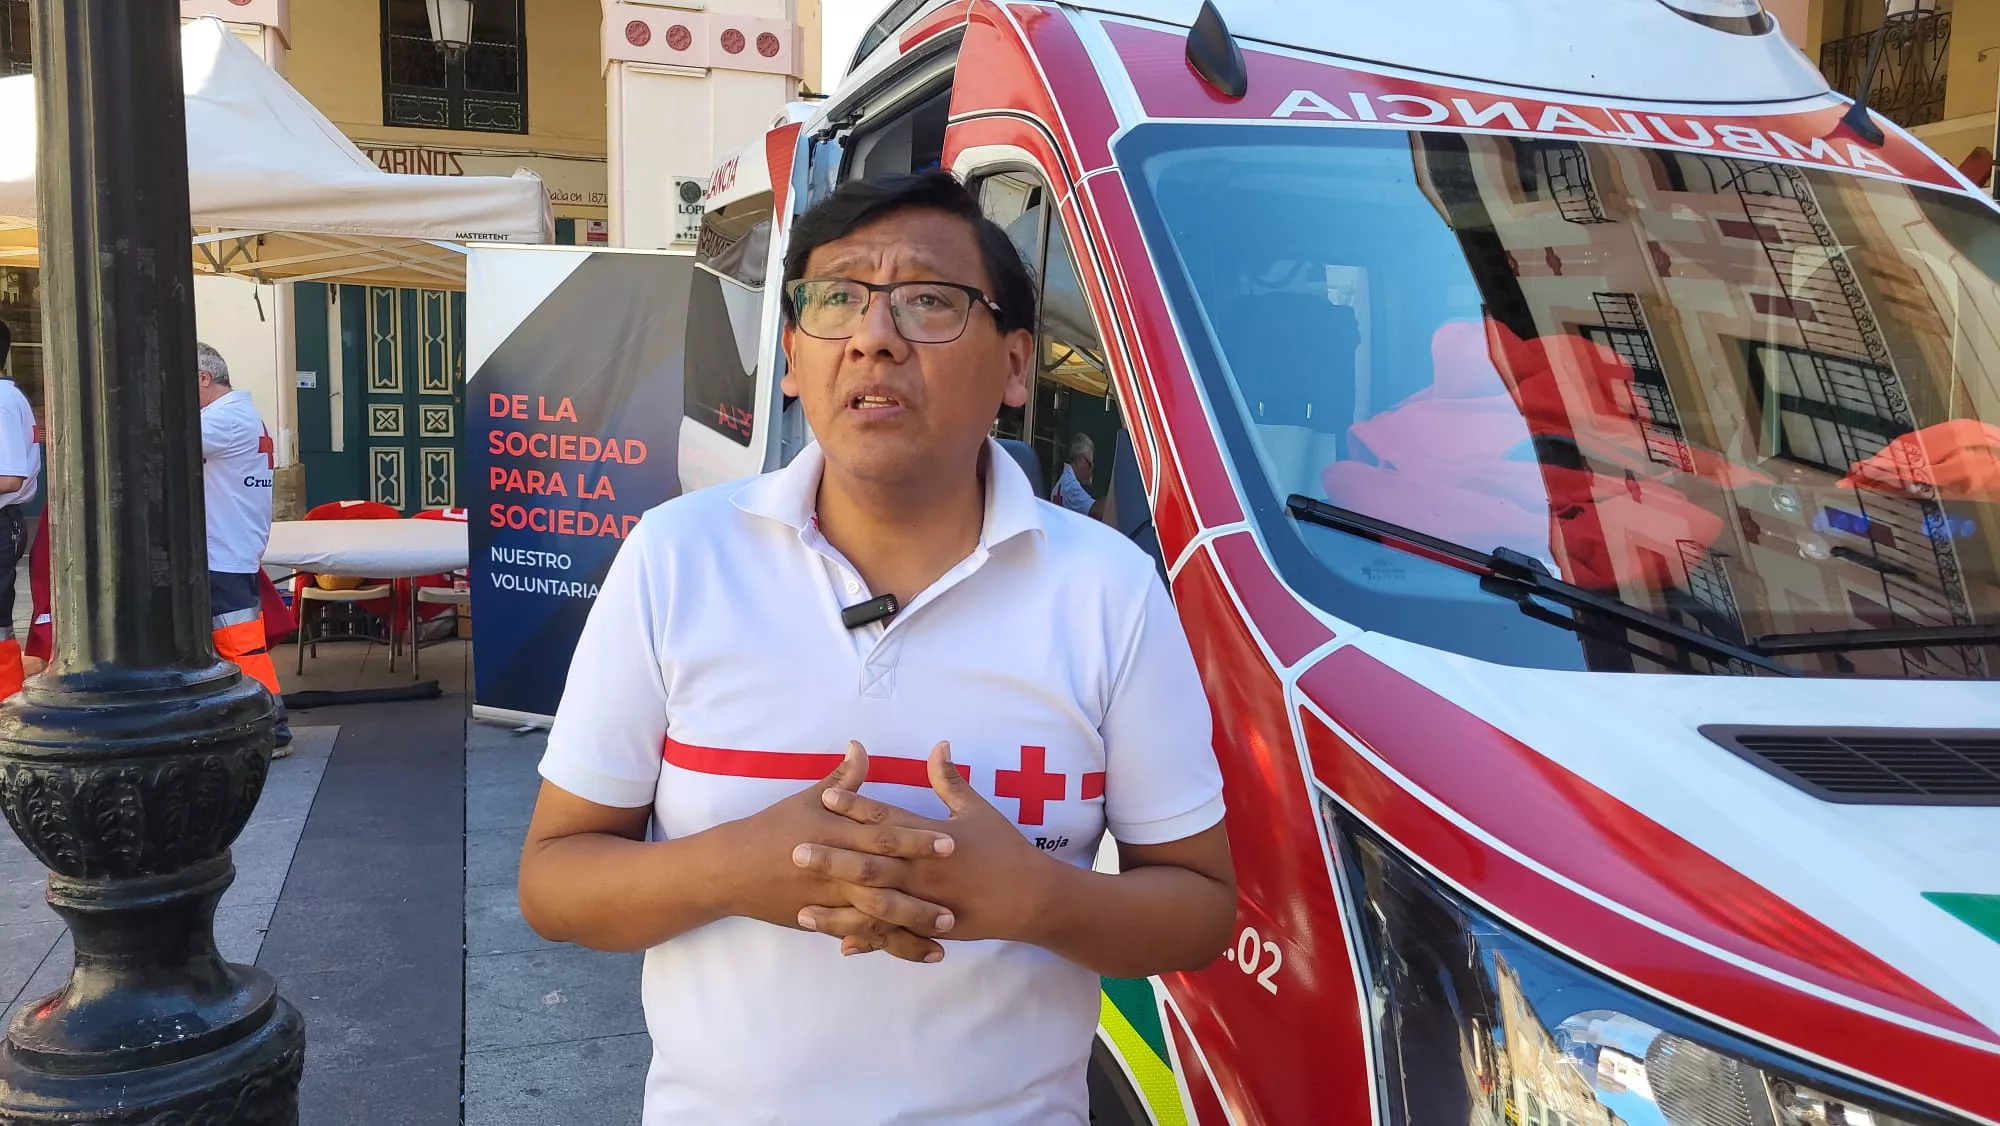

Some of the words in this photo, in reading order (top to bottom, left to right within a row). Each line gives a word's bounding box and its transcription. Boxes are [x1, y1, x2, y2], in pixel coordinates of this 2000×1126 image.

[588, 191, 607, 205] 1871
[455, 232, 510, 240] MASTERTENT
[489, 392, 529, 420] DE
[538, 396, 578, 423] LA
[488, 429, 647, 465] SOCIEDAD
[489, 466, 568, 497] PARA
[577, 473, 616, 500] LA
[491, 546, 572, 570] NUESTRO
[1035, 835, 1069, 851] Roja
